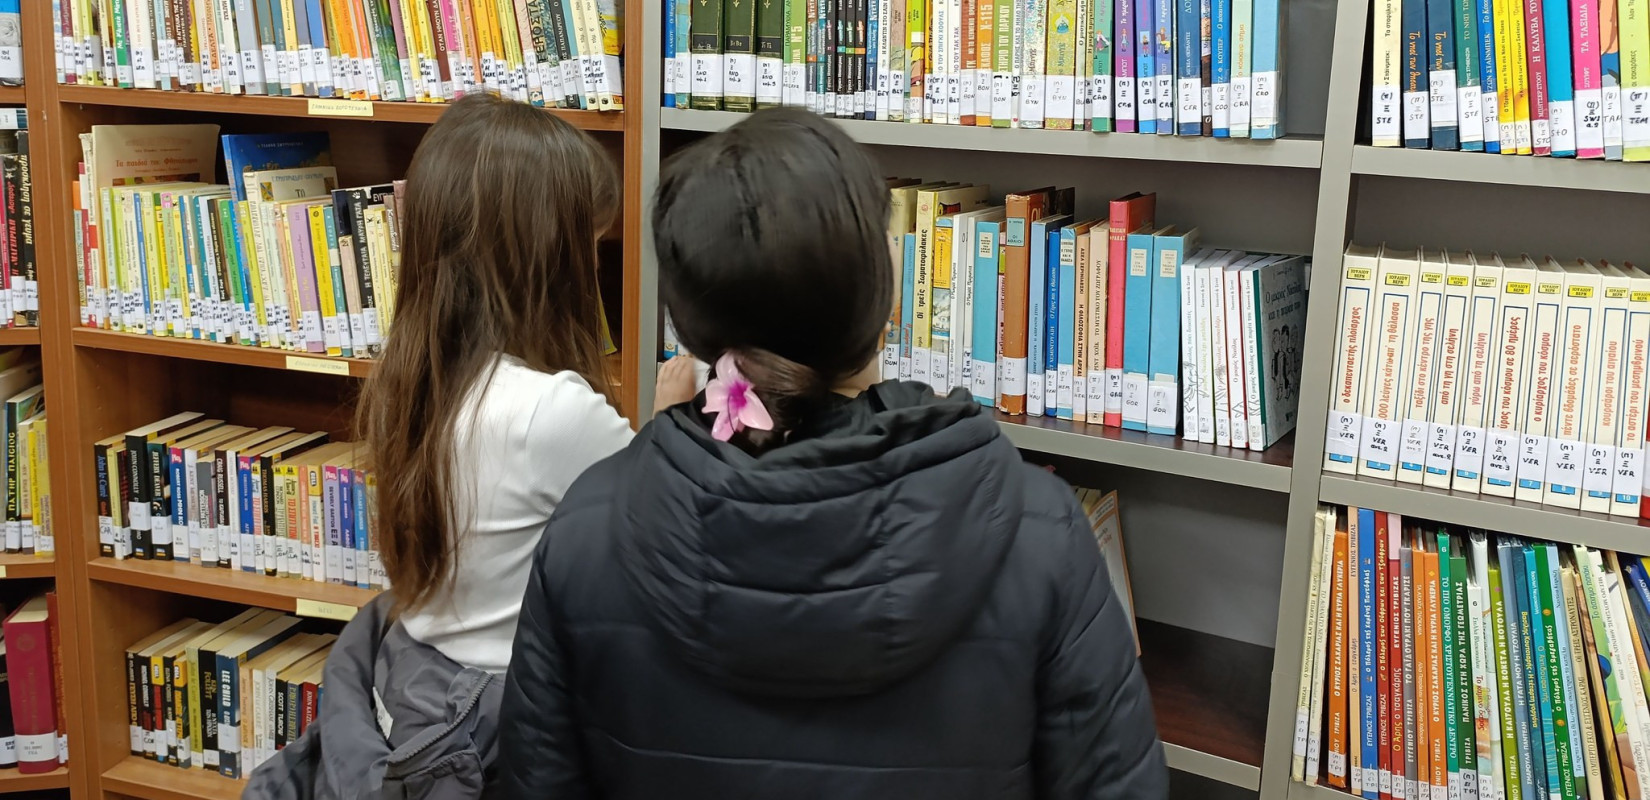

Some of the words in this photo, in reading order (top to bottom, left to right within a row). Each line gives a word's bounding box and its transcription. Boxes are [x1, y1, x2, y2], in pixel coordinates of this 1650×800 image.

[436, 8, 444, 33] ΗΜΟΥΝ
[999, 5, 1009, 32] ΠΑΡΚΟΥ
[1580, 4, 1588, 38] ΤΑΞΙΔΙΑ
[999, 35, 1009, 47] ΤΟΥ
[1409, 31, 1420, 40] Το
[1464, 30, 1470, 40] ΤΟ
[1531, 17, 1540, 51] ΚΑΛΥΒΑ
[1581, 41, 1589, 53] ΤΑ
[24, 206, 31, 216] σε
[356, 202, 364, 218] ΓΑΤΑ
[357, 218, 367, 243] ΜΑΥΡΗ
[361, 246, 371, 280] ΤΕΛΕΥΤΑΙΑ
[918, 230, 927, 284] Σωματοφύλακες
[1348, 307, 1361, 343] πλοίαρχος
[1387, 302, 1399, 333] θάλασσα
[1424, 318, 1434, 330] γης
[1094, 328, 1100, 336] ΤΟ
[1388, 334, 1398, 343] τη
[1422, 332, 1433, 345] της
[1445, 328, 1458, 354] σελήνη
[1507, 317, 1520, 343] ημέρες
[1474, 333, 1487, 358] σελήνη
[1505, 345, 1515, 355] 80
[1538, 333, 1550, 360] κόσμου
[1569, 325, 1581, 364] αερόστατο
[1606, 341, 1617, 369] αιγαίου
[1417, 347, 1430, 372] κέντρο
[1445, 356, 1456, 369] στη
[1475, 360, 1485, 369] τη
[1506, 357, 1514, 366] σε
[1538, 362, 1547, 374] του
[1632, 340, 1643, 389] μεσημβρινού
[1342, 345, 1357, 397] δεκαπενταετής
[1418, 373, 1426, 386] στο
[1444, 370, 1454, 379] γη
[1472, 371, 1482, 385] από
[1501, 368, 1514, 394] κόσμου
[1569, 367, 1578, 376] σε
[1606, 371, 1615, 384] του
[1380, 378, 1393, 402] λεύγες
[1443, 381, 1452, 389] τη
[1469, 386, 1481, 405] γύρω
[1533, 377, 1547, 415] κυρίαρχος
[1563, 378, 1578, 412] βδομάδες
[1414, 388, 1425, 408] ταξίδι
[1440, 391, 1449, 405] από
[1502, 396, 1510, 409] του
[1602, 387, 1614, 426] κουρσάροι
[1630, 390, 1639, 404] του
[1497, 411, 1511, 429] ύρος
[1561, 414, 1573, 435] πέντε
[1626, 406, 1639, 431] αστέρι
[1339, 432, 1354, 440] VER
[1627, 432, 1635, 441] το
[152, 451, 160, 473] JEFFERY
[1442, 577, 1449, 588] ΤΟ
[1456, 582, 1464, 628] ΓΕΩΜΕΤΡΙΑΣ
[1567, 596, 1580, 636] ΑΣΤΡΟΝΑΥΤΕΣ
[1443, 607, 1451, 642] ΟΜΟΡΦΟ
[1494, 599, 1505, 640] ΚΟΤΟΥΛΑ
[1403, 626, 1412, 671] ΓΑΪΔΟΥΡΑΚΙ
[1510, 621, 1520, 654] ΤΖΟΥΛΙΑ
[1573, 636, 1583, 654] ΤΡΕΙΣ
[1499, 650, 1508, 680] ΚΟΚΕΤΑ
[1575, 653, 1583, 662] ΟΙ
[204, 672, 213, 699] FOLLETT
[222, 670, 230, 683] LEE
[1405, 673, 1412, 684] ΤΟ
[1445, 645, 1455, 724] ΧΡΙΣΤΟΥΓΕΝΝΙΑΤΙΚΟ
[222, 684, 231, 707] CHILD
[1392, 668, 1401, 711] τσαγκάρης
[1461, 689, 1469, 722] ΠΑΝΙΚΟΣ
[1393, 721, 1402, 742] Άρης
[1524, 753, 1532, 784] ΣΜΑΡΟΥΛΑ
